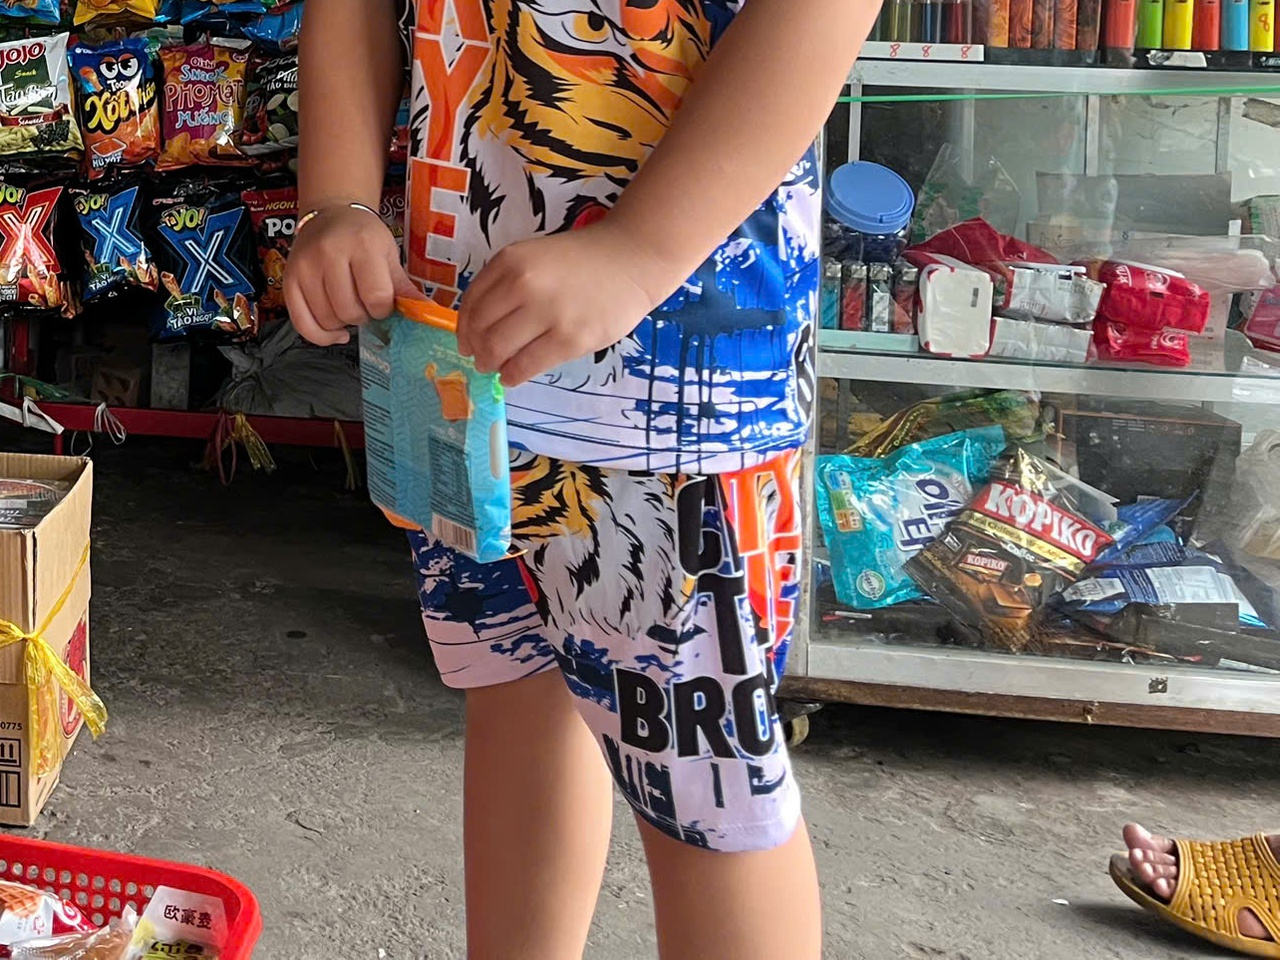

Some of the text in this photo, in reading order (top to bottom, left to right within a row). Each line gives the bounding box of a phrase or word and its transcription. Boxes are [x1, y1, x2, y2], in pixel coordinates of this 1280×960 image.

[889, 43, 901, 58] 8
[922, 44, 933, 59] 8
[961, 44, 972, 59] 8
[191, 57, 216, 68] Oishi
[265, 217, 296, 237] PO
[986, 482, 1098, 559] KOPIKO
